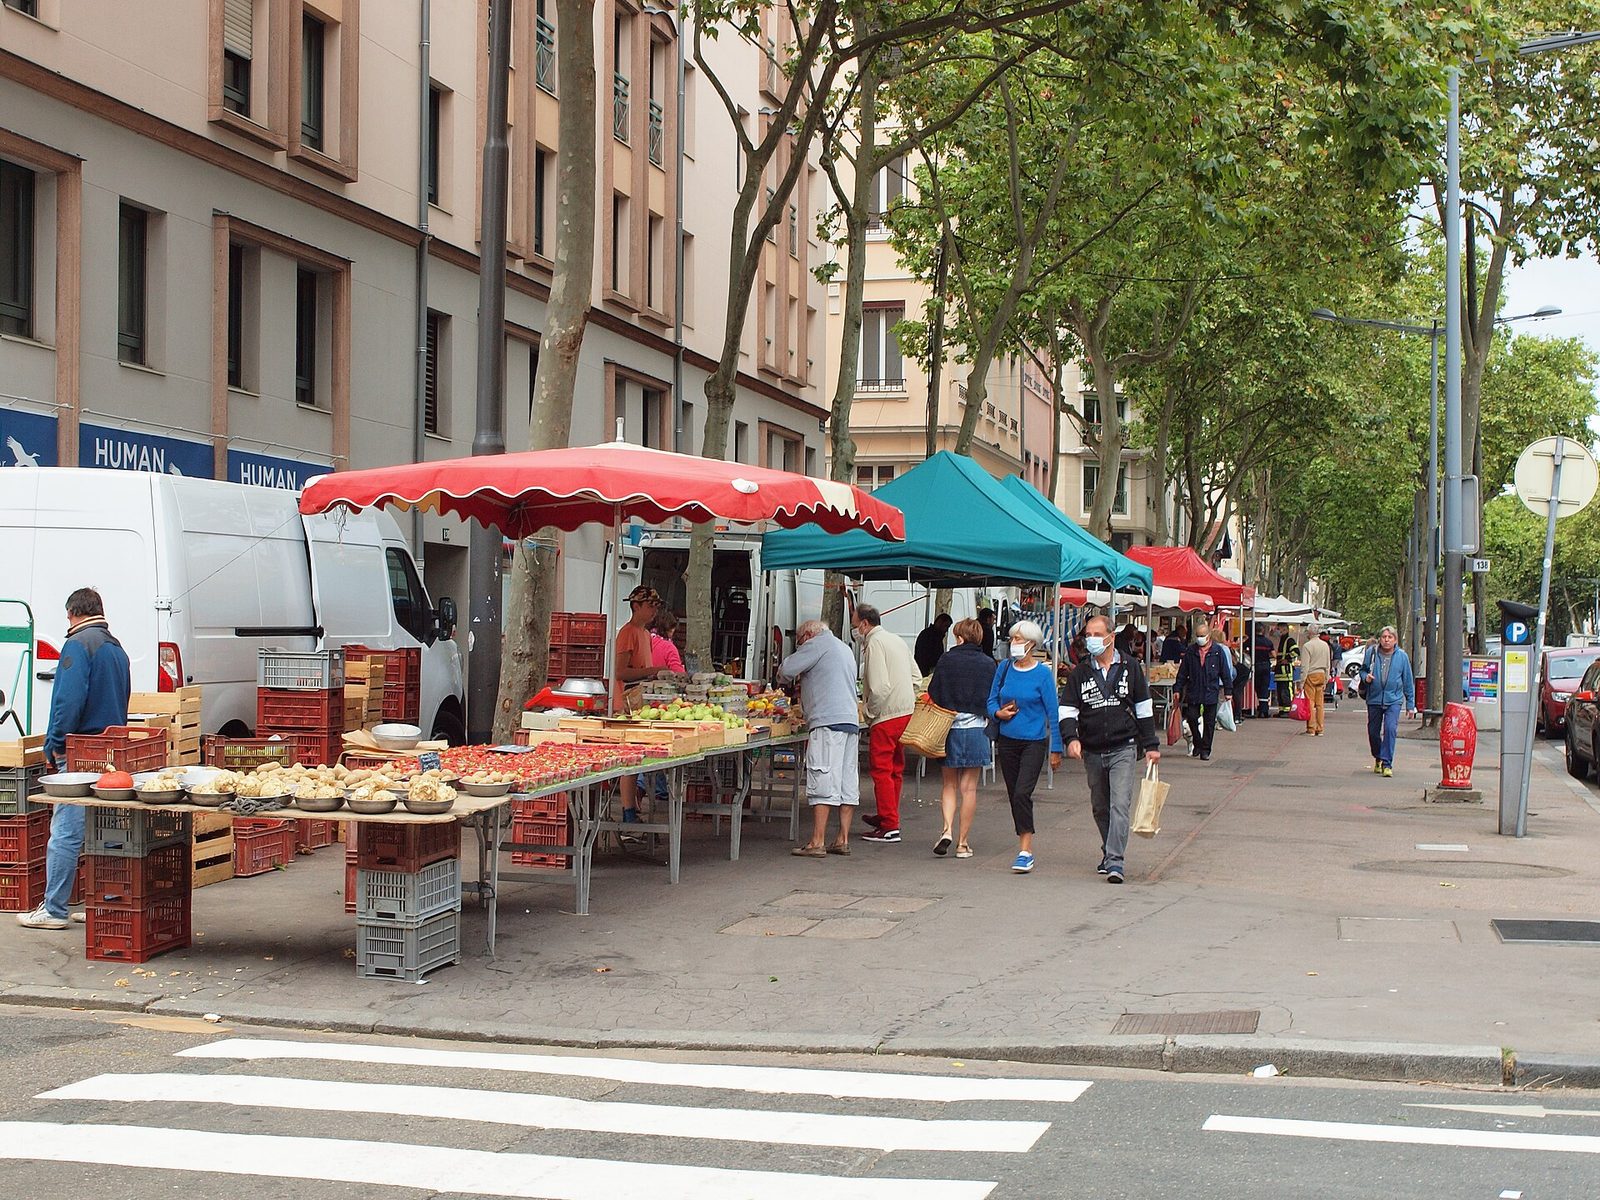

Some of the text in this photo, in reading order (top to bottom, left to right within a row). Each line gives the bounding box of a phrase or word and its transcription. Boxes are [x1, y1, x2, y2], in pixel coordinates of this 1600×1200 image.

[95, 437, 165, 474] HUMAN
[240, 462, 296, 490] HUMAN
[1513, 622, 1526, 643] P
